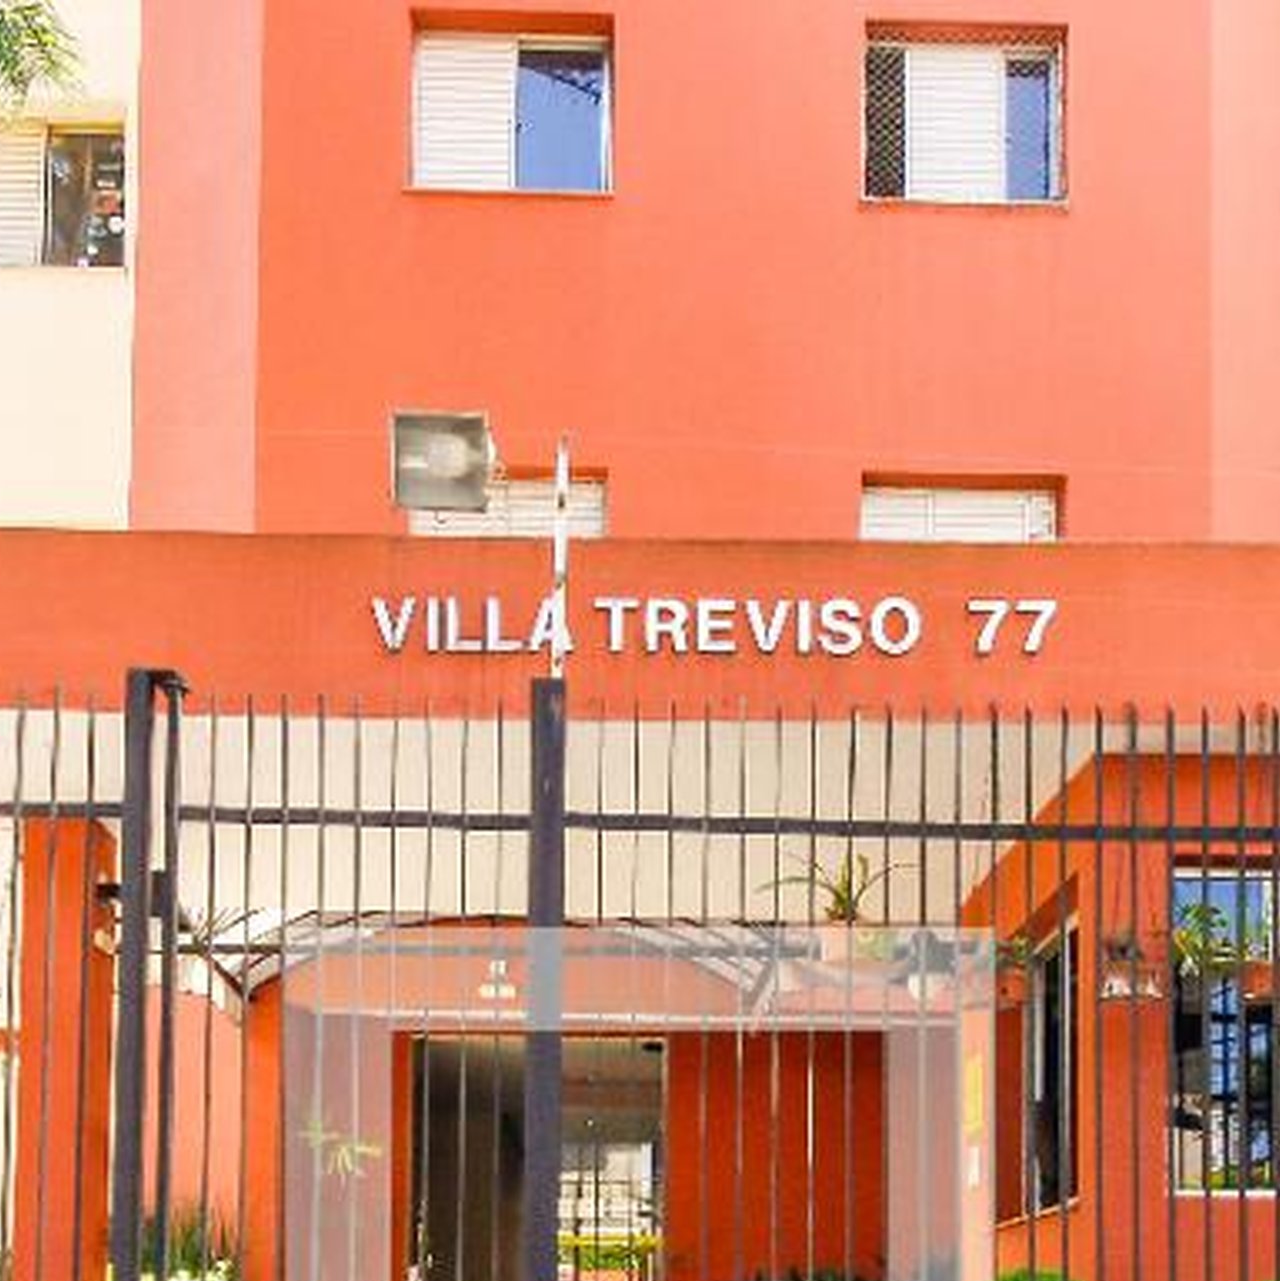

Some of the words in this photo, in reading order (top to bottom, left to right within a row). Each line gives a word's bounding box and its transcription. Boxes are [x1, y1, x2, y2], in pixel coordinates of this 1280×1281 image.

[371, 596, 574, 653] VILLA
[594, 596, 921, 655] TREVISO
[967, 598, 1058, 654] 77
